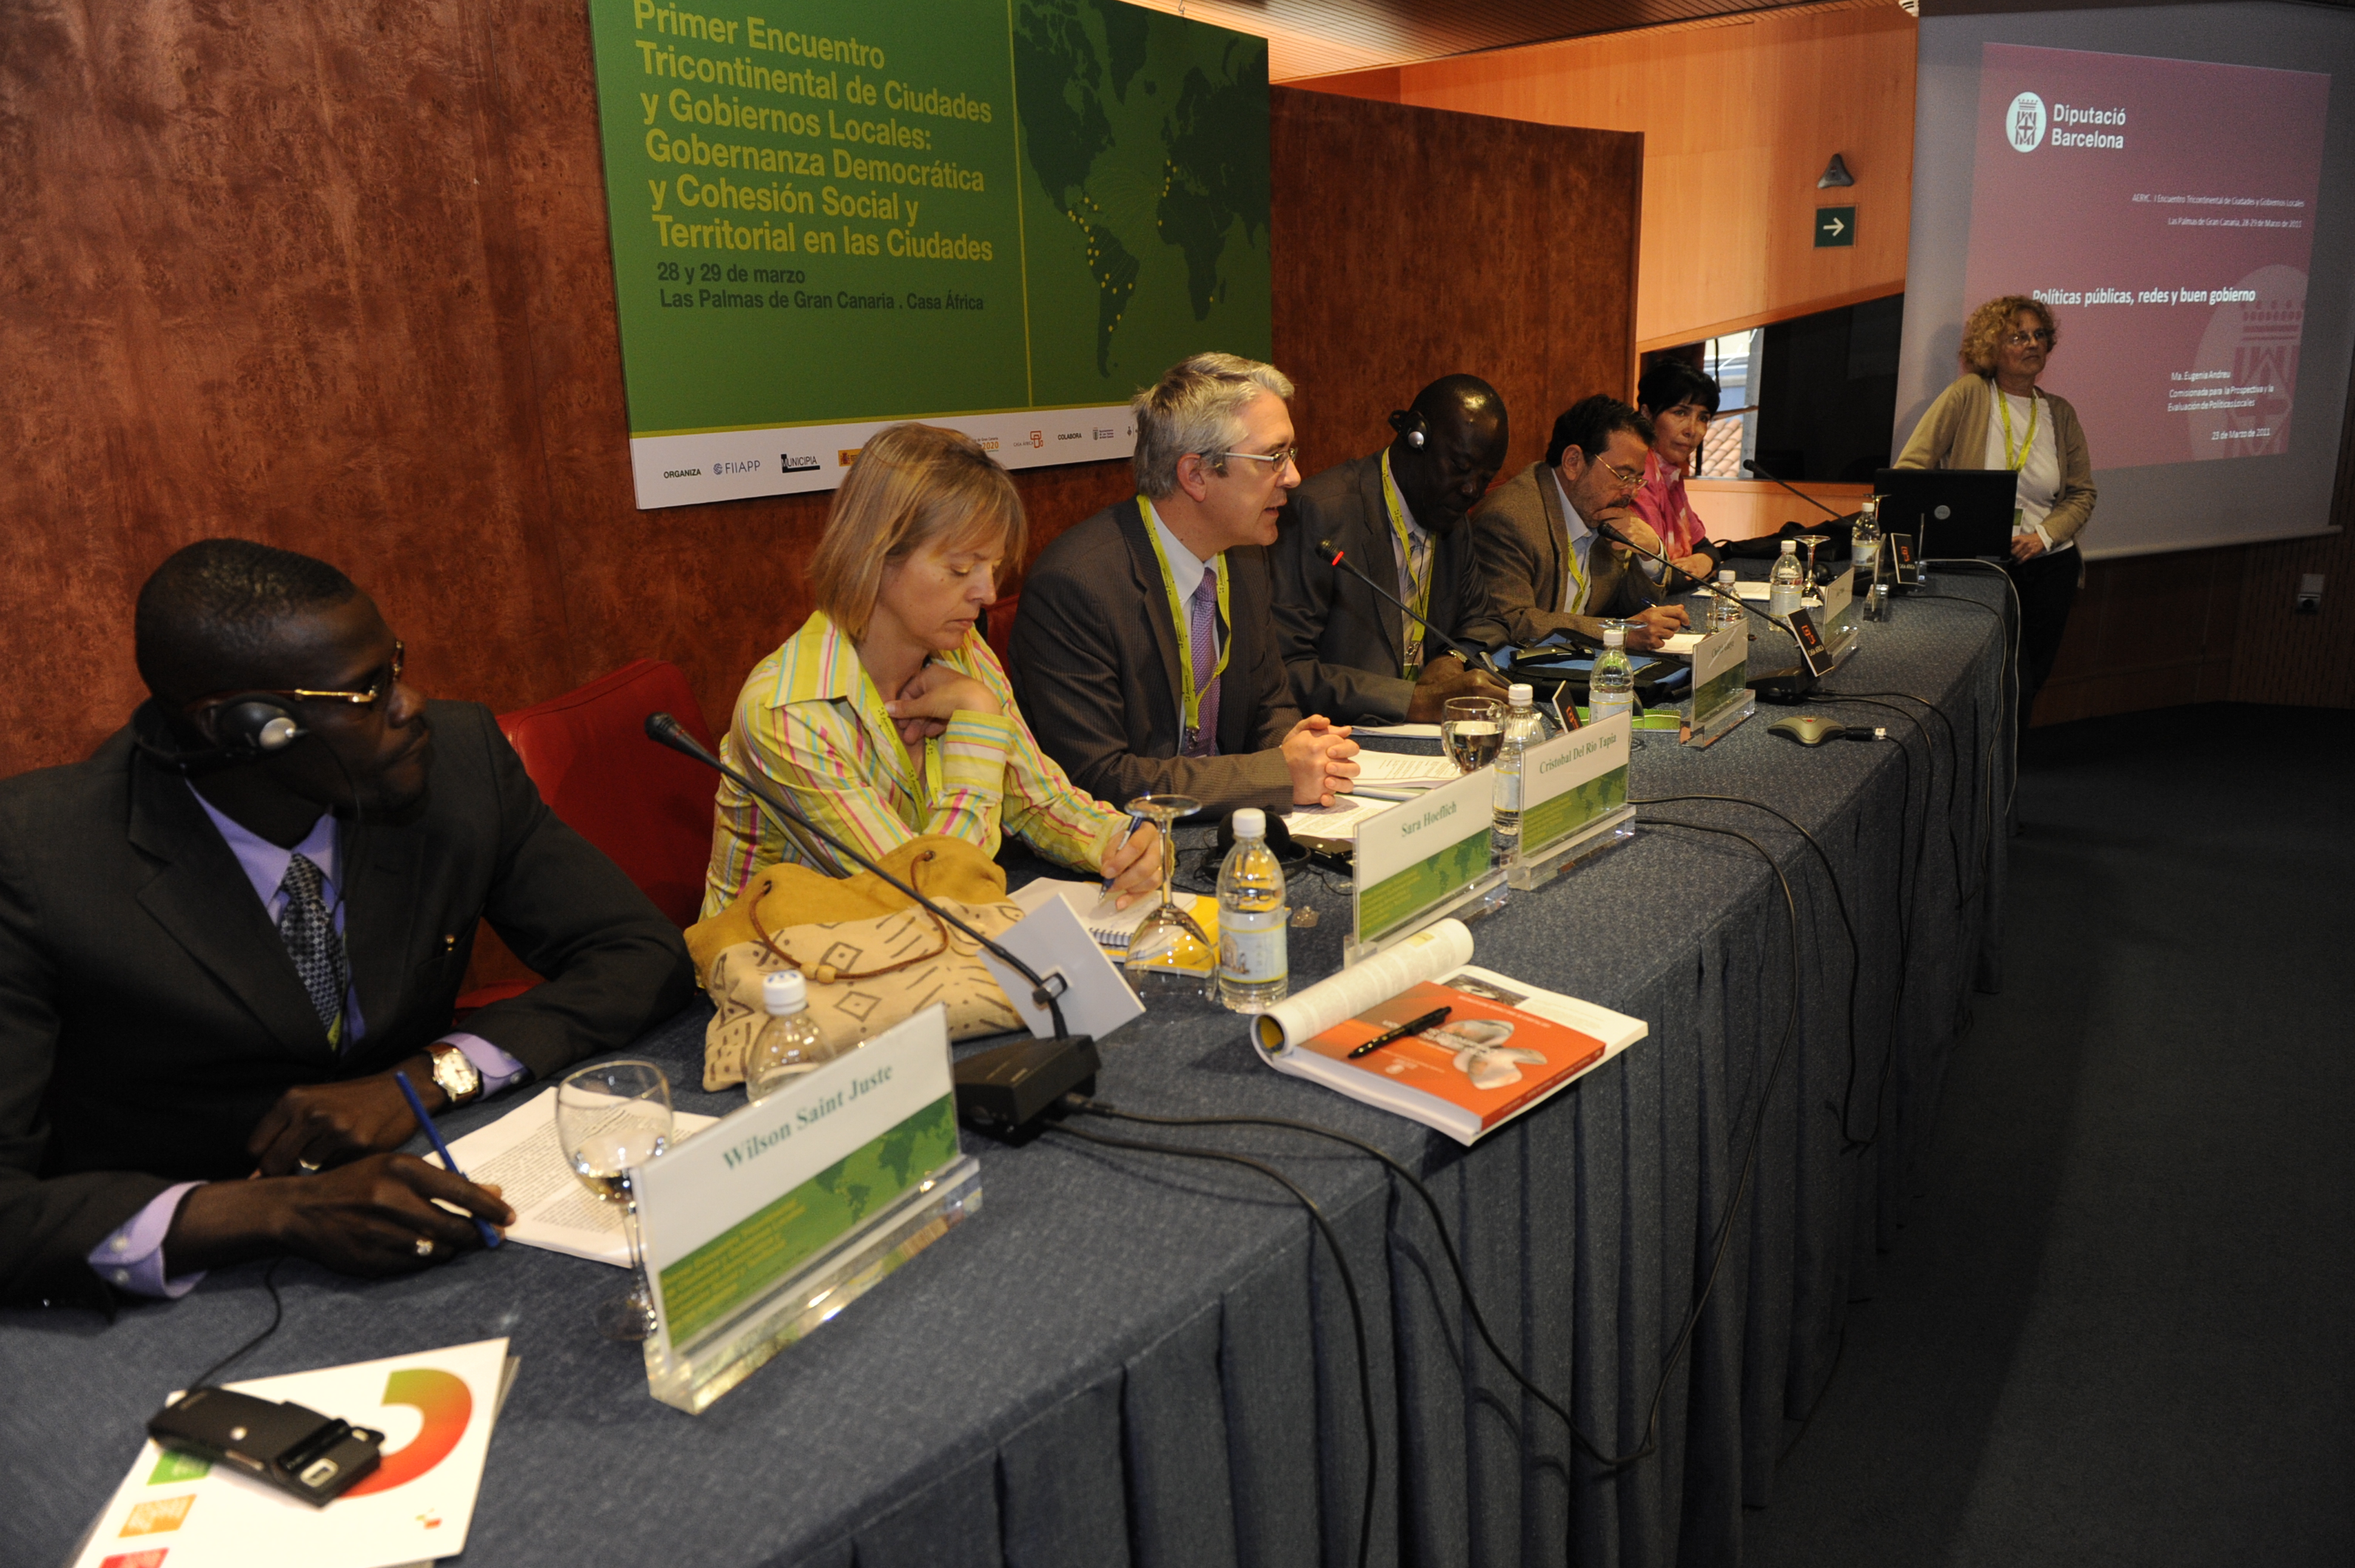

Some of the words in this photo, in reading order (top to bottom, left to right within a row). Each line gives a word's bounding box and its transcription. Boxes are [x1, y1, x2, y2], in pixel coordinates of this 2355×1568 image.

[634, 0, 738, 44] Primer
[748, 16, 885, 69] Encuentro
[636, 40, 837, 101] Tricontinental
[846, 75, 876, 107] de
[885, 81, 992, 123] Ciudades
[641, 91, 658, 124] y
[669, 89, 820, 137] Gobiernos
[828, 110, 932, 149] Locales:
[2053, 104, 2126, 126] Diputació
[2051, 128, 2124, 149] Barcelona
[646, 129, 825, 177] Gobernanza
[834, 149, 984, 192] Democrática
[649, 178, 666, 211] y
[677, 174, 813, 214] Cohesión
[822, 186, 898, 220] Social
[905, 199, 919, 226] y
[2158, 194, 2185, 203] Encuentro
[652, 214, 796, 251] Territorial
[804, 230, 836, 253] en
[844, 226, 879, 256] las
[888, 229, 993, 261] Ciudades
[658, 262, 679, 282] 28
[685, 266, 695, 285] y
[700, 263, 721, 282] 29
[726, 263, 749, 283] de
[754, 268, 805, 284] marzo
[660, 289, 693, 308] Las
[700, 289, 763, 308] Palmas
[769, 291, 788, 309] de
[794, 291, 832, 309] Gran
[837, 292, 894, 310] Canaria
[907, 294, 942, 311] Casa
[945, 289, 984, 311] África
[2033, 289, 2081, 305] Políticas
[2084, 287, 2134, 307] públicas,
[2138, 288, 2169, 303] redes
[2171, 291, 2178, 306] y
[2180, 287, 2207, 303] buen
[2209, 287, 2256, 305] gobierno
[2184, 371, 2208, 382] Eugenia
[982, 441, 999, 450] 2020
[1058, 432, 1082, 441] COLABORA
[663, 468, 701, 479] ORGANIZA
[725, 460, 760, 474] FIIAPP
[1539, 750, 1572, 774] Cristobal
[1573, 745, 1584, 760] Del
[1586, 741, 1597, 754] Rio
[1598, 732, 1617, 748] Tapia
[1402, 820, 1422, 837] Sara
[1424, 801, 1457, 827] Hoeflich
[723, 1122, 791, 1170] Wilson
[796, 1089, 845, 1130] Saint
[848, 1065, 893, 1101] Juste
